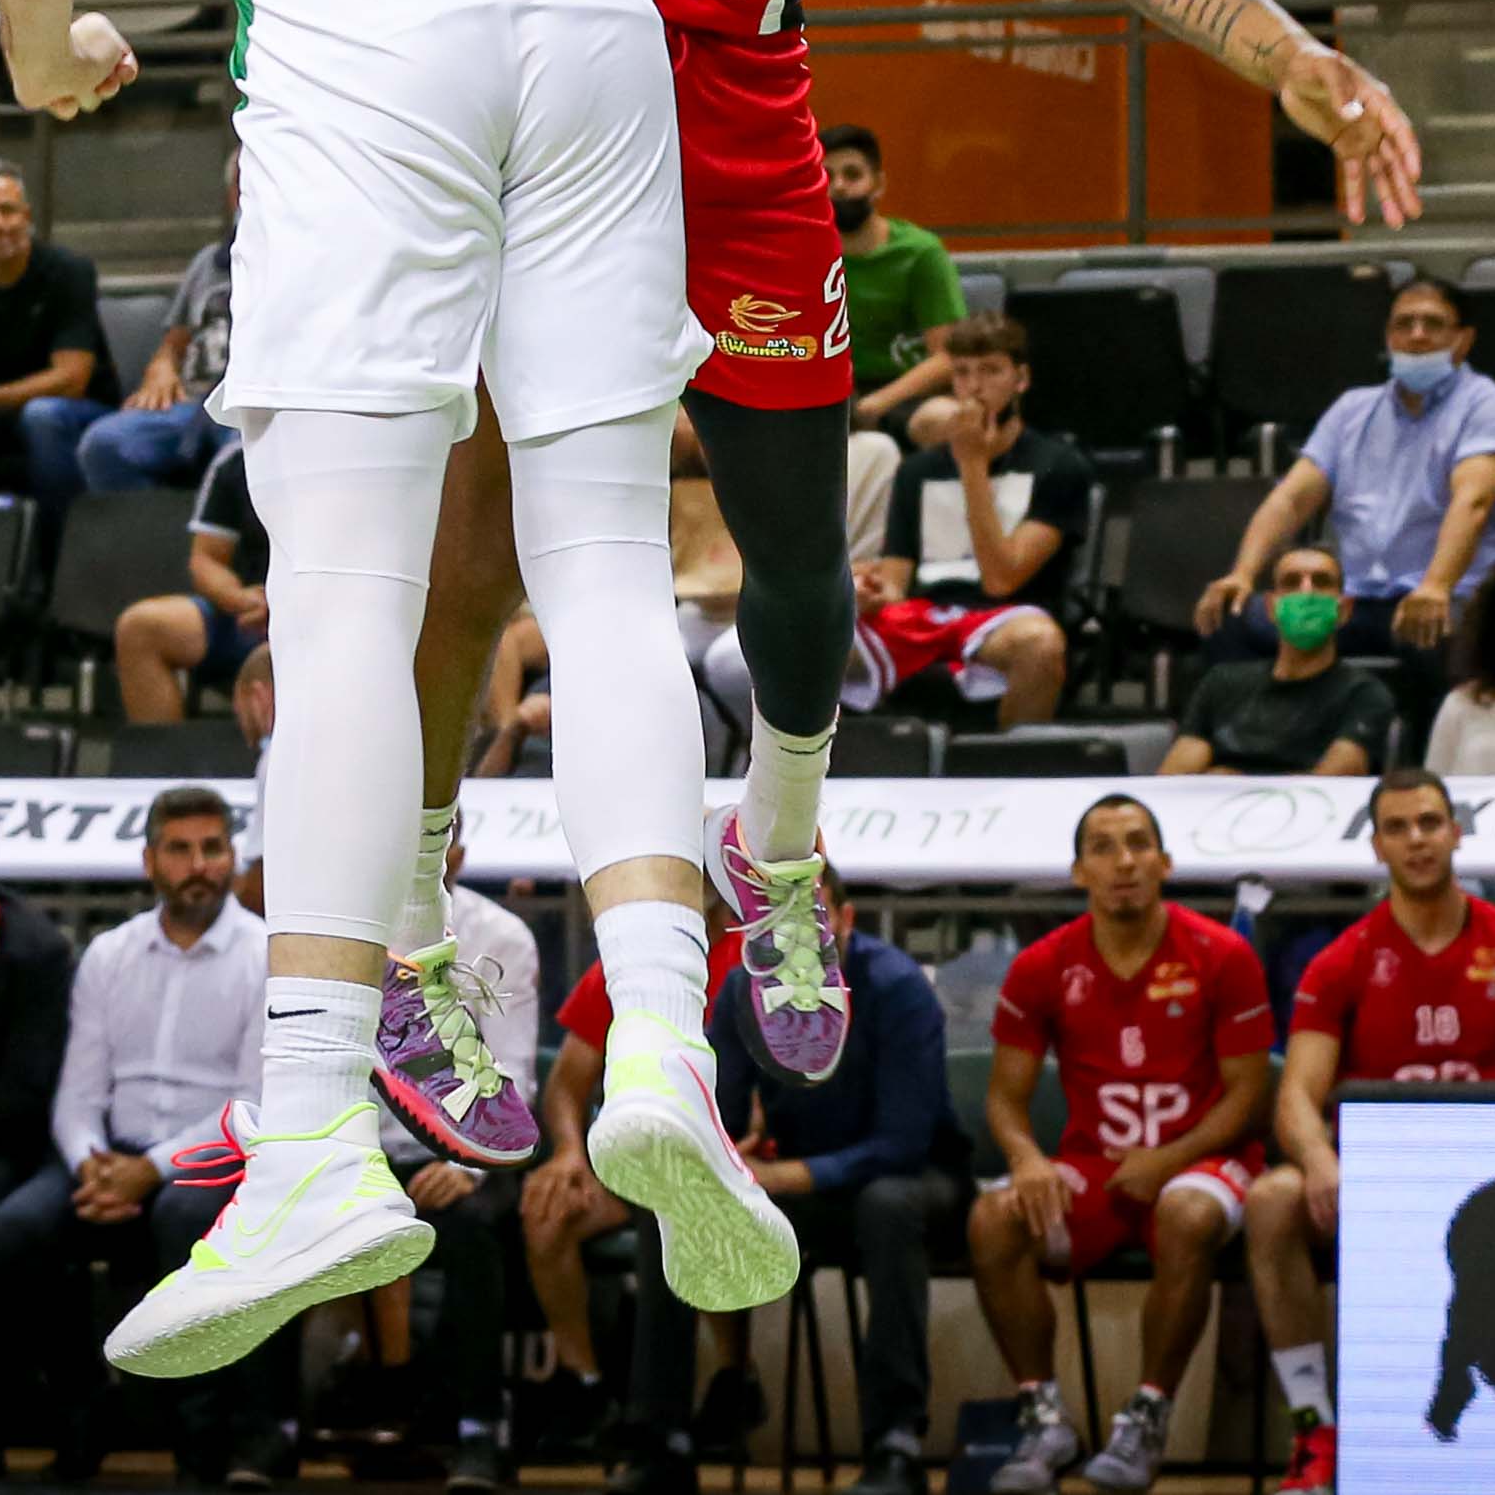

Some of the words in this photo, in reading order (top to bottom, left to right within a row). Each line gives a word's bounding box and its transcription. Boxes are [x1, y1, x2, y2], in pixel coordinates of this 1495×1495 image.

[823, 256, 851, 359] 2
[727, 337, 790, 356] Winner
[790, 345, 806, 356] סל
[1097, 1082, 1190, 1148] SP
